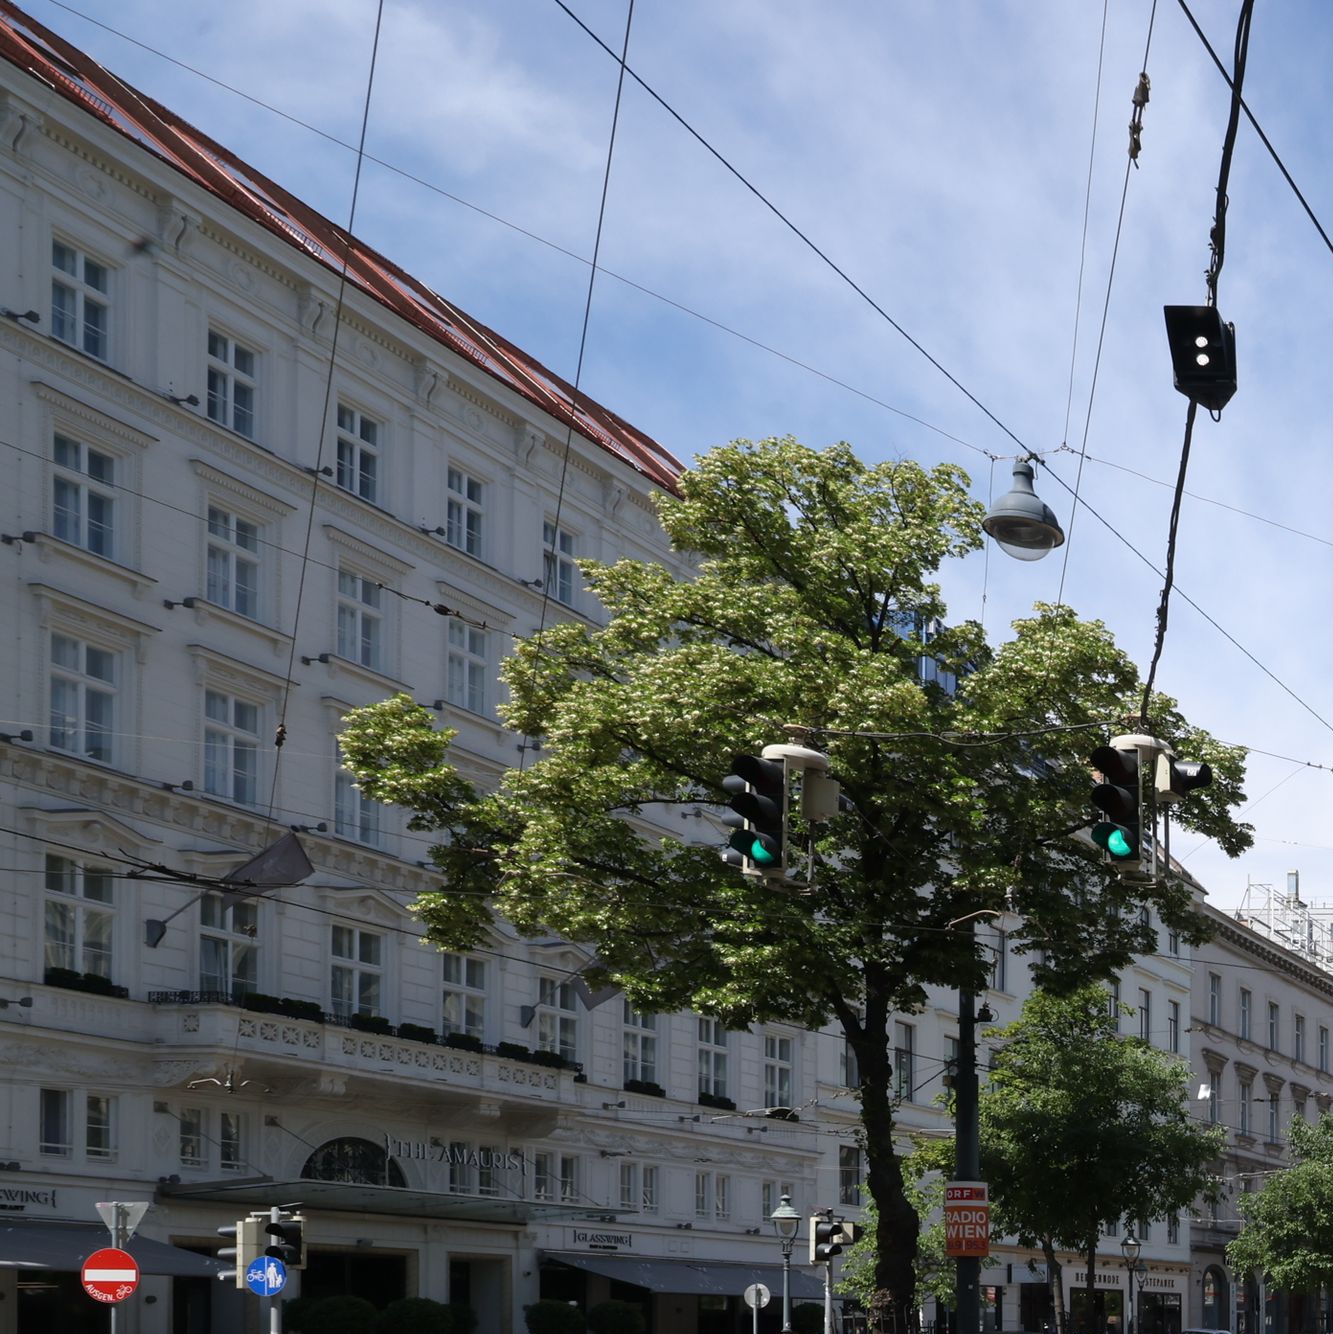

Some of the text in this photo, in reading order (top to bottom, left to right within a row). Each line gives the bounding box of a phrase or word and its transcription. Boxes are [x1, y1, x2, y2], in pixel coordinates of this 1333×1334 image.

[947, 1190, 972, 1199] ORF
[946, 1211, 987, 1224] RADIO
[947, 1224, 987, 1239] WIEN
[85, 1283, 116, 1302] AUSGEN.
